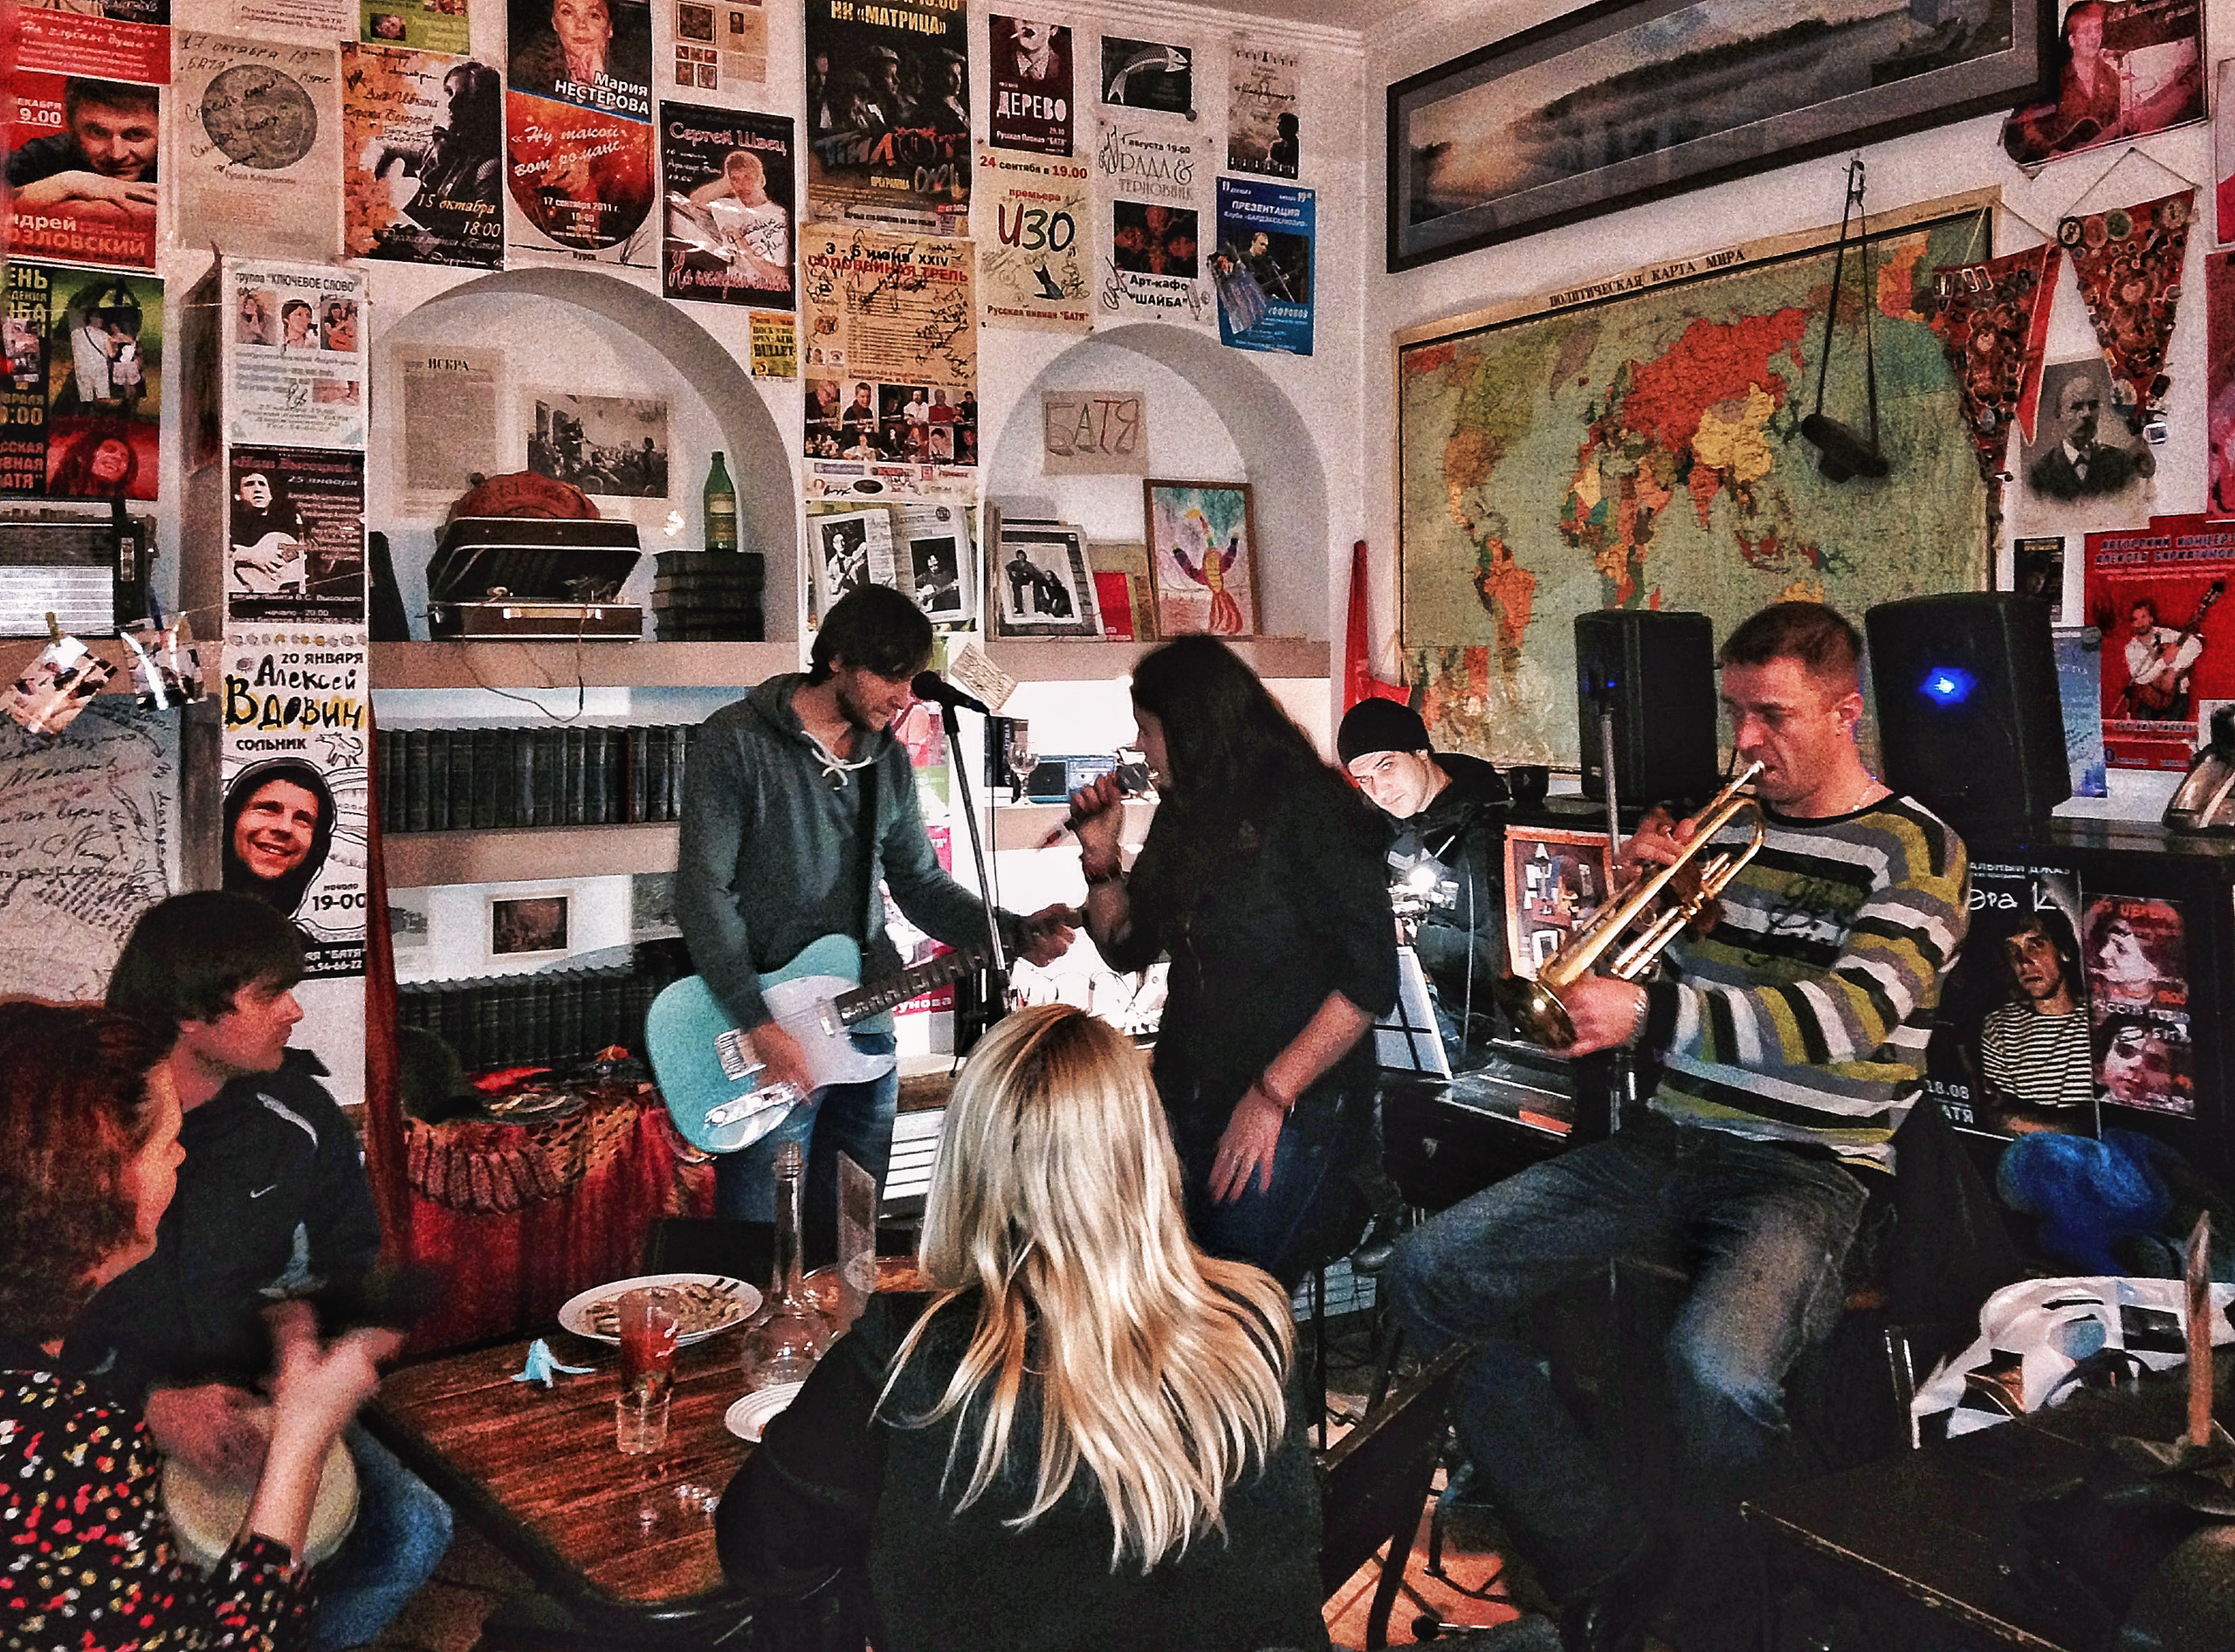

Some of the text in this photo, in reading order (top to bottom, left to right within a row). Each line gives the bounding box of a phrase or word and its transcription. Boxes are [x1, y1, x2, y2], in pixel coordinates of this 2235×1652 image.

[554, 79, 650, 115] НЕСТЕРОВА
[595, 72, 648, 97] Мария
[996, 91, 1067, 122] ДЕРЕВО
[980, 155, 996, 168] 24
[999, 161, 1041, 174] сентября
[1052, 165, 1088, 179] 19.00
[1232, 200, 1301, 217] ПРЕЗЕНТАЦИЯ
[10, 229, 146, 256] ОЗЛОВСКИЙ
[1549, 249, 1745, 307] ПОЛИТИЧЕСКАЯ КАРТА МИРА
[0, 441, 45, 453] ССКАЯ
[0, 456, 45, 471] ВНАЯ
[281, 652, 363, 664] 20 ЯНВАРЯ
[253, 654, 356, 690] Алексей
